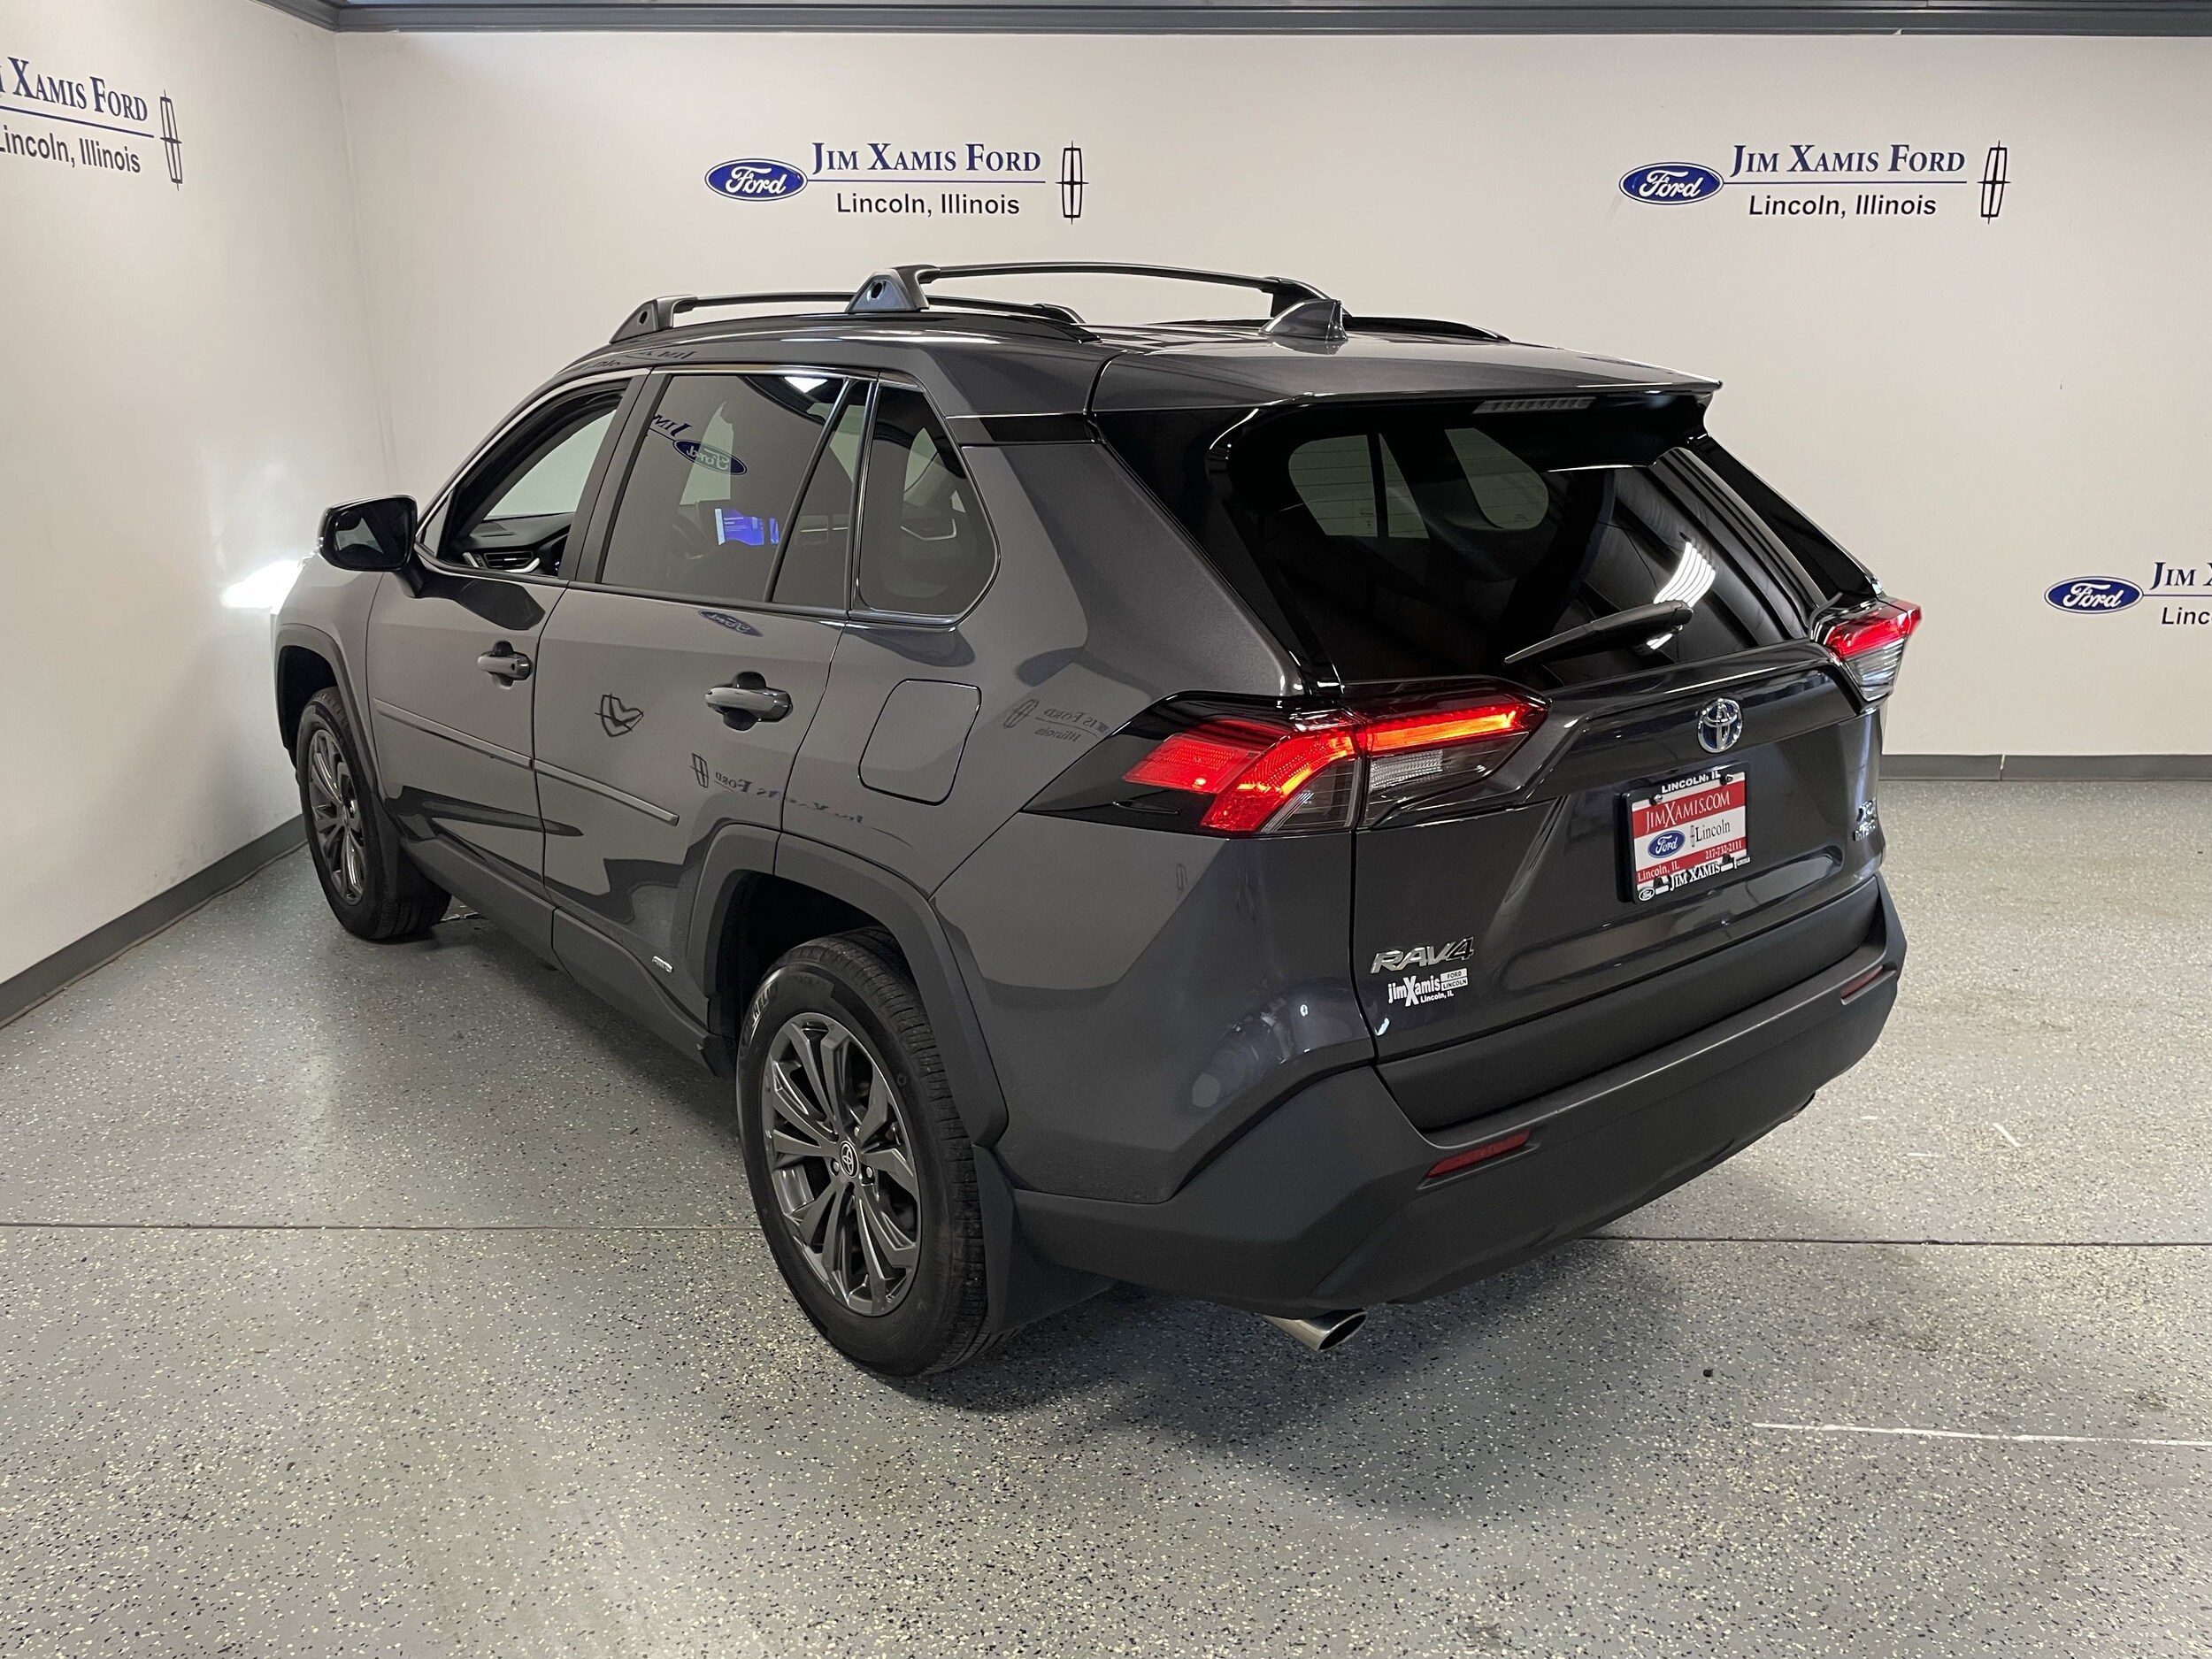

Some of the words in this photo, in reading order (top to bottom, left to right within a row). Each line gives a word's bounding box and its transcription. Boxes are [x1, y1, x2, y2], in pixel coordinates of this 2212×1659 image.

[79, 137, 141, 173] Illinois
[726, 165, 787, 194] Ford
[1639, 169, 1704, 197] Ford
[837, 193, 933, 218] Lincoln,
[941, 193, 1019, 214] Illinois
[1749, 195, 1846, 219] Lincoln,
[1855, 195, 1937, 215] Illinois
[2062, 582, 2124, 608] Ford
[2162, 607, 2212, 625] Linc
[1695, 818, 1731, 842] Lincoln
[1655, 834, 1678, 854] Ford
[1705, 841, 1742, 860] 217-732-2111
[1671, 861, 1680, 870] IL
[1688, 863, 1721, 883] XAMIS
[1370, 936, 1474, 974] RAV4
[1442, 979, 1467, 989] LINCOLN
[1447, 971, 1462, 979] FORD
